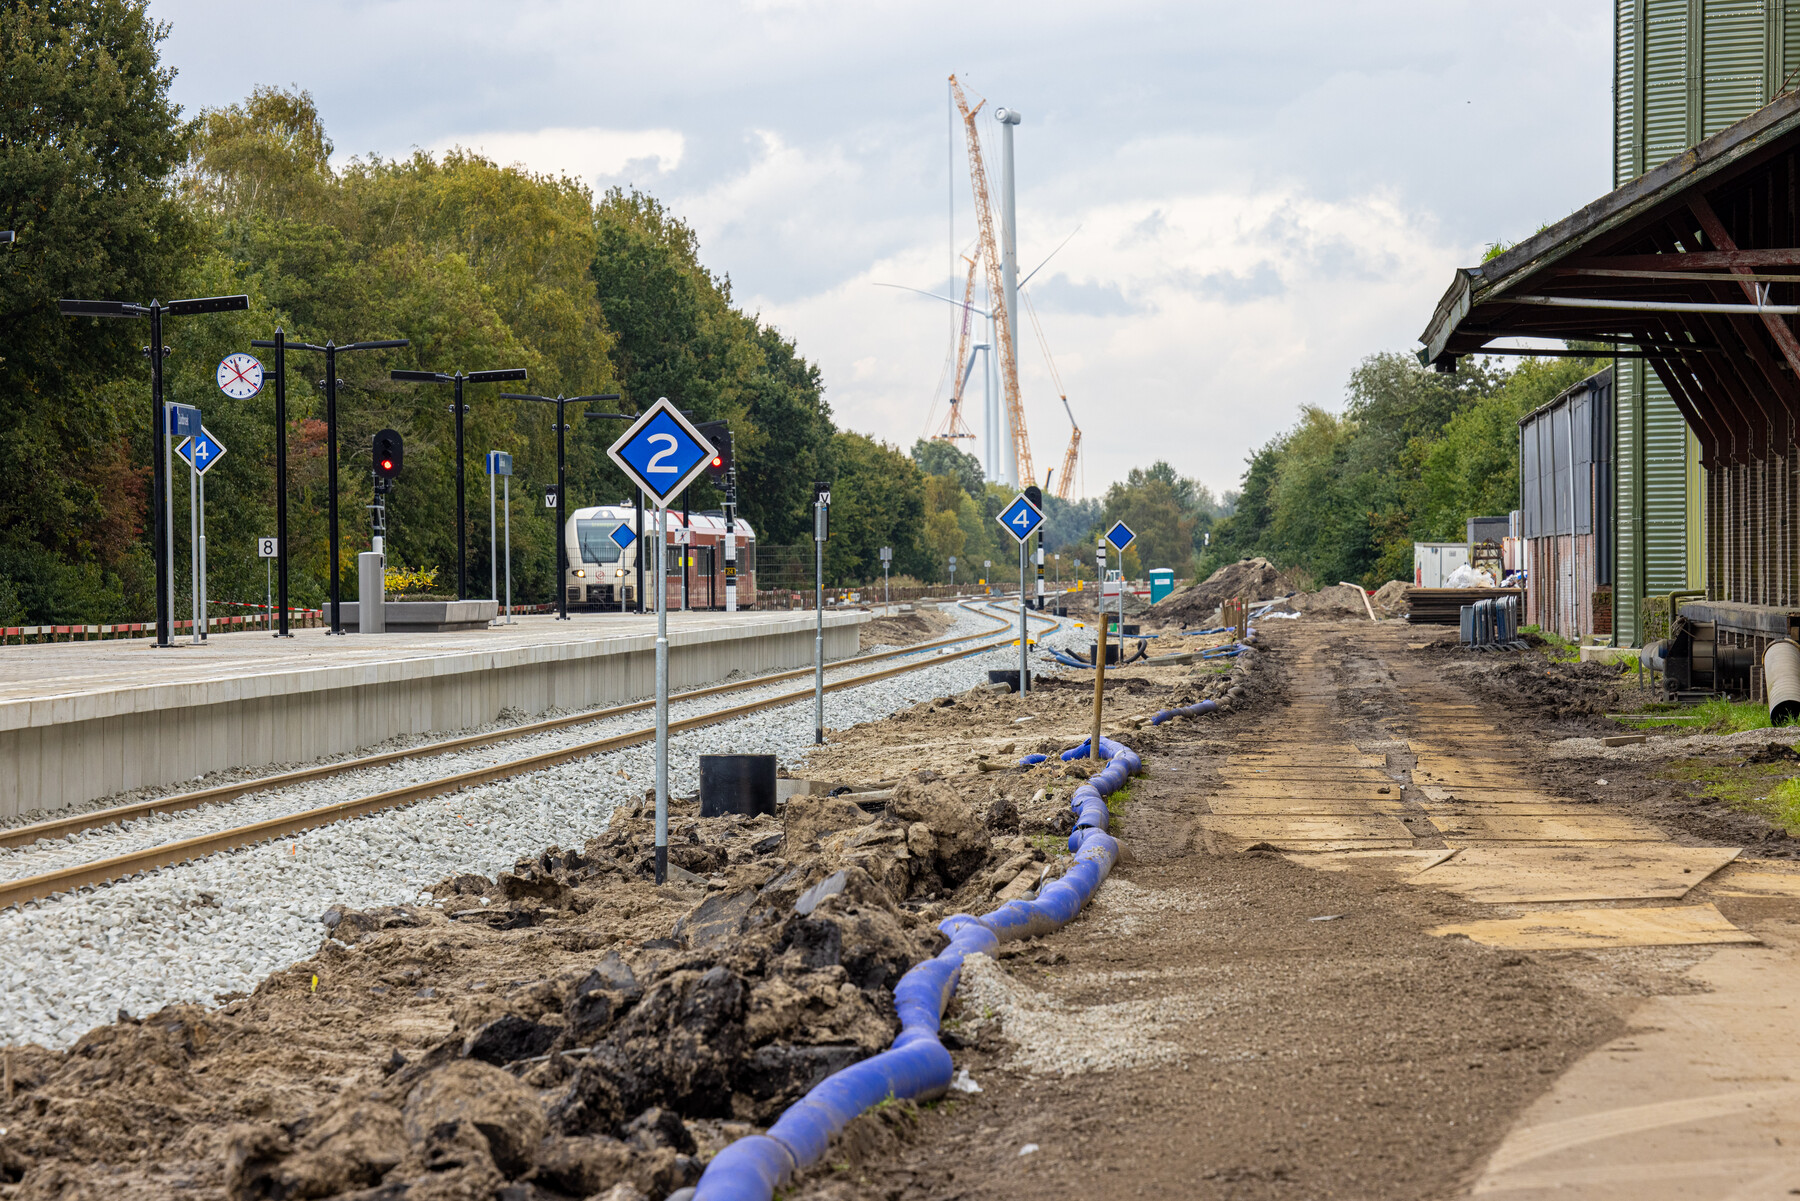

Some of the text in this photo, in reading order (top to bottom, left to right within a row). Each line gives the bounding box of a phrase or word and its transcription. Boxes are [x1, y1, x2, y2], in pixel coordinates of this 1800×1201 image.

[196, 441, 209, 460] 4
[647, 433, 678, 473] 2
[547, 496, 555, 506] V
[821, 494, 829, 503] V
[1013, 509, 1029, 528] 4
[264, 540, 273, 555] 8
